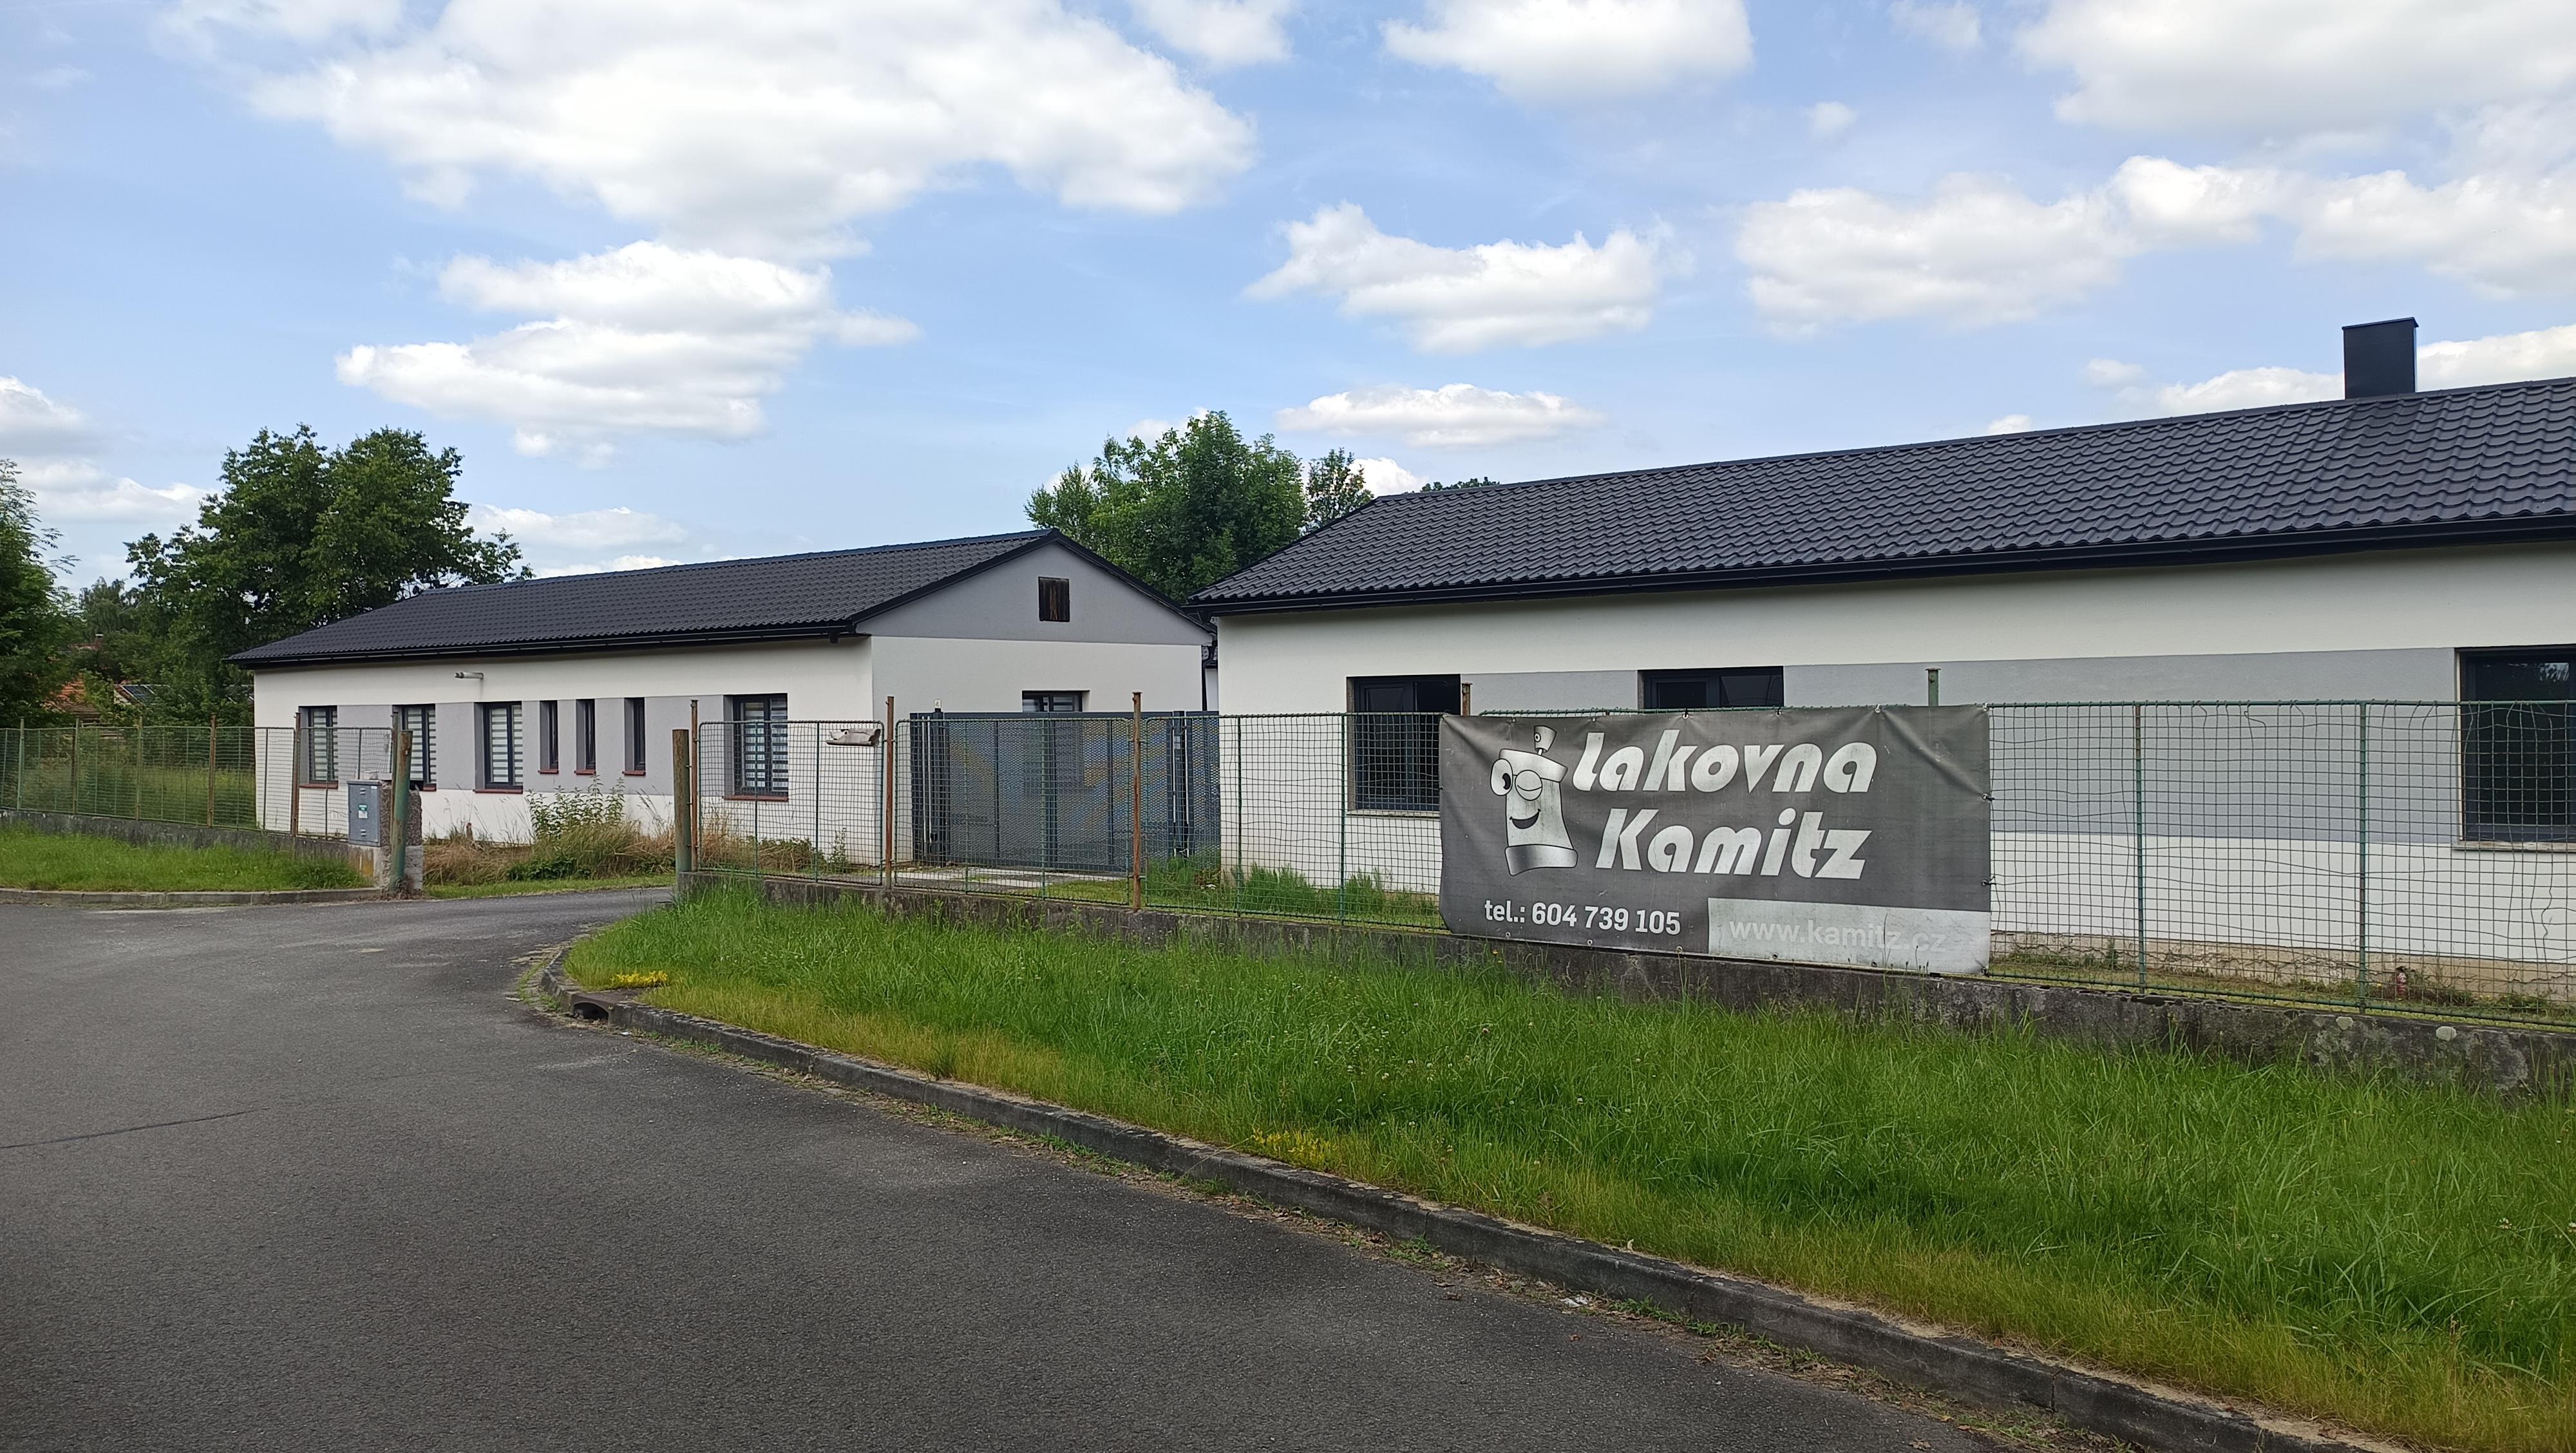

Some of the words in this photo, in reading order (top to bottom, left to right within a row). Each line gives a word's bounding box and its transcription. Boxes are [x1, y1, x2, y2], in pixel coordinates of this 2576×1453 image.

[1595, 807, 1873, 880] Kamitz
[1484, 900, 1526, 923] tel.:
[1531, 902, 1577, 927] 604
[1584, 906, 1629, 931] 739
[1635, 909, 1681, 935] 105
[1728, 919, 1947, 953] www.kamitz.cz
